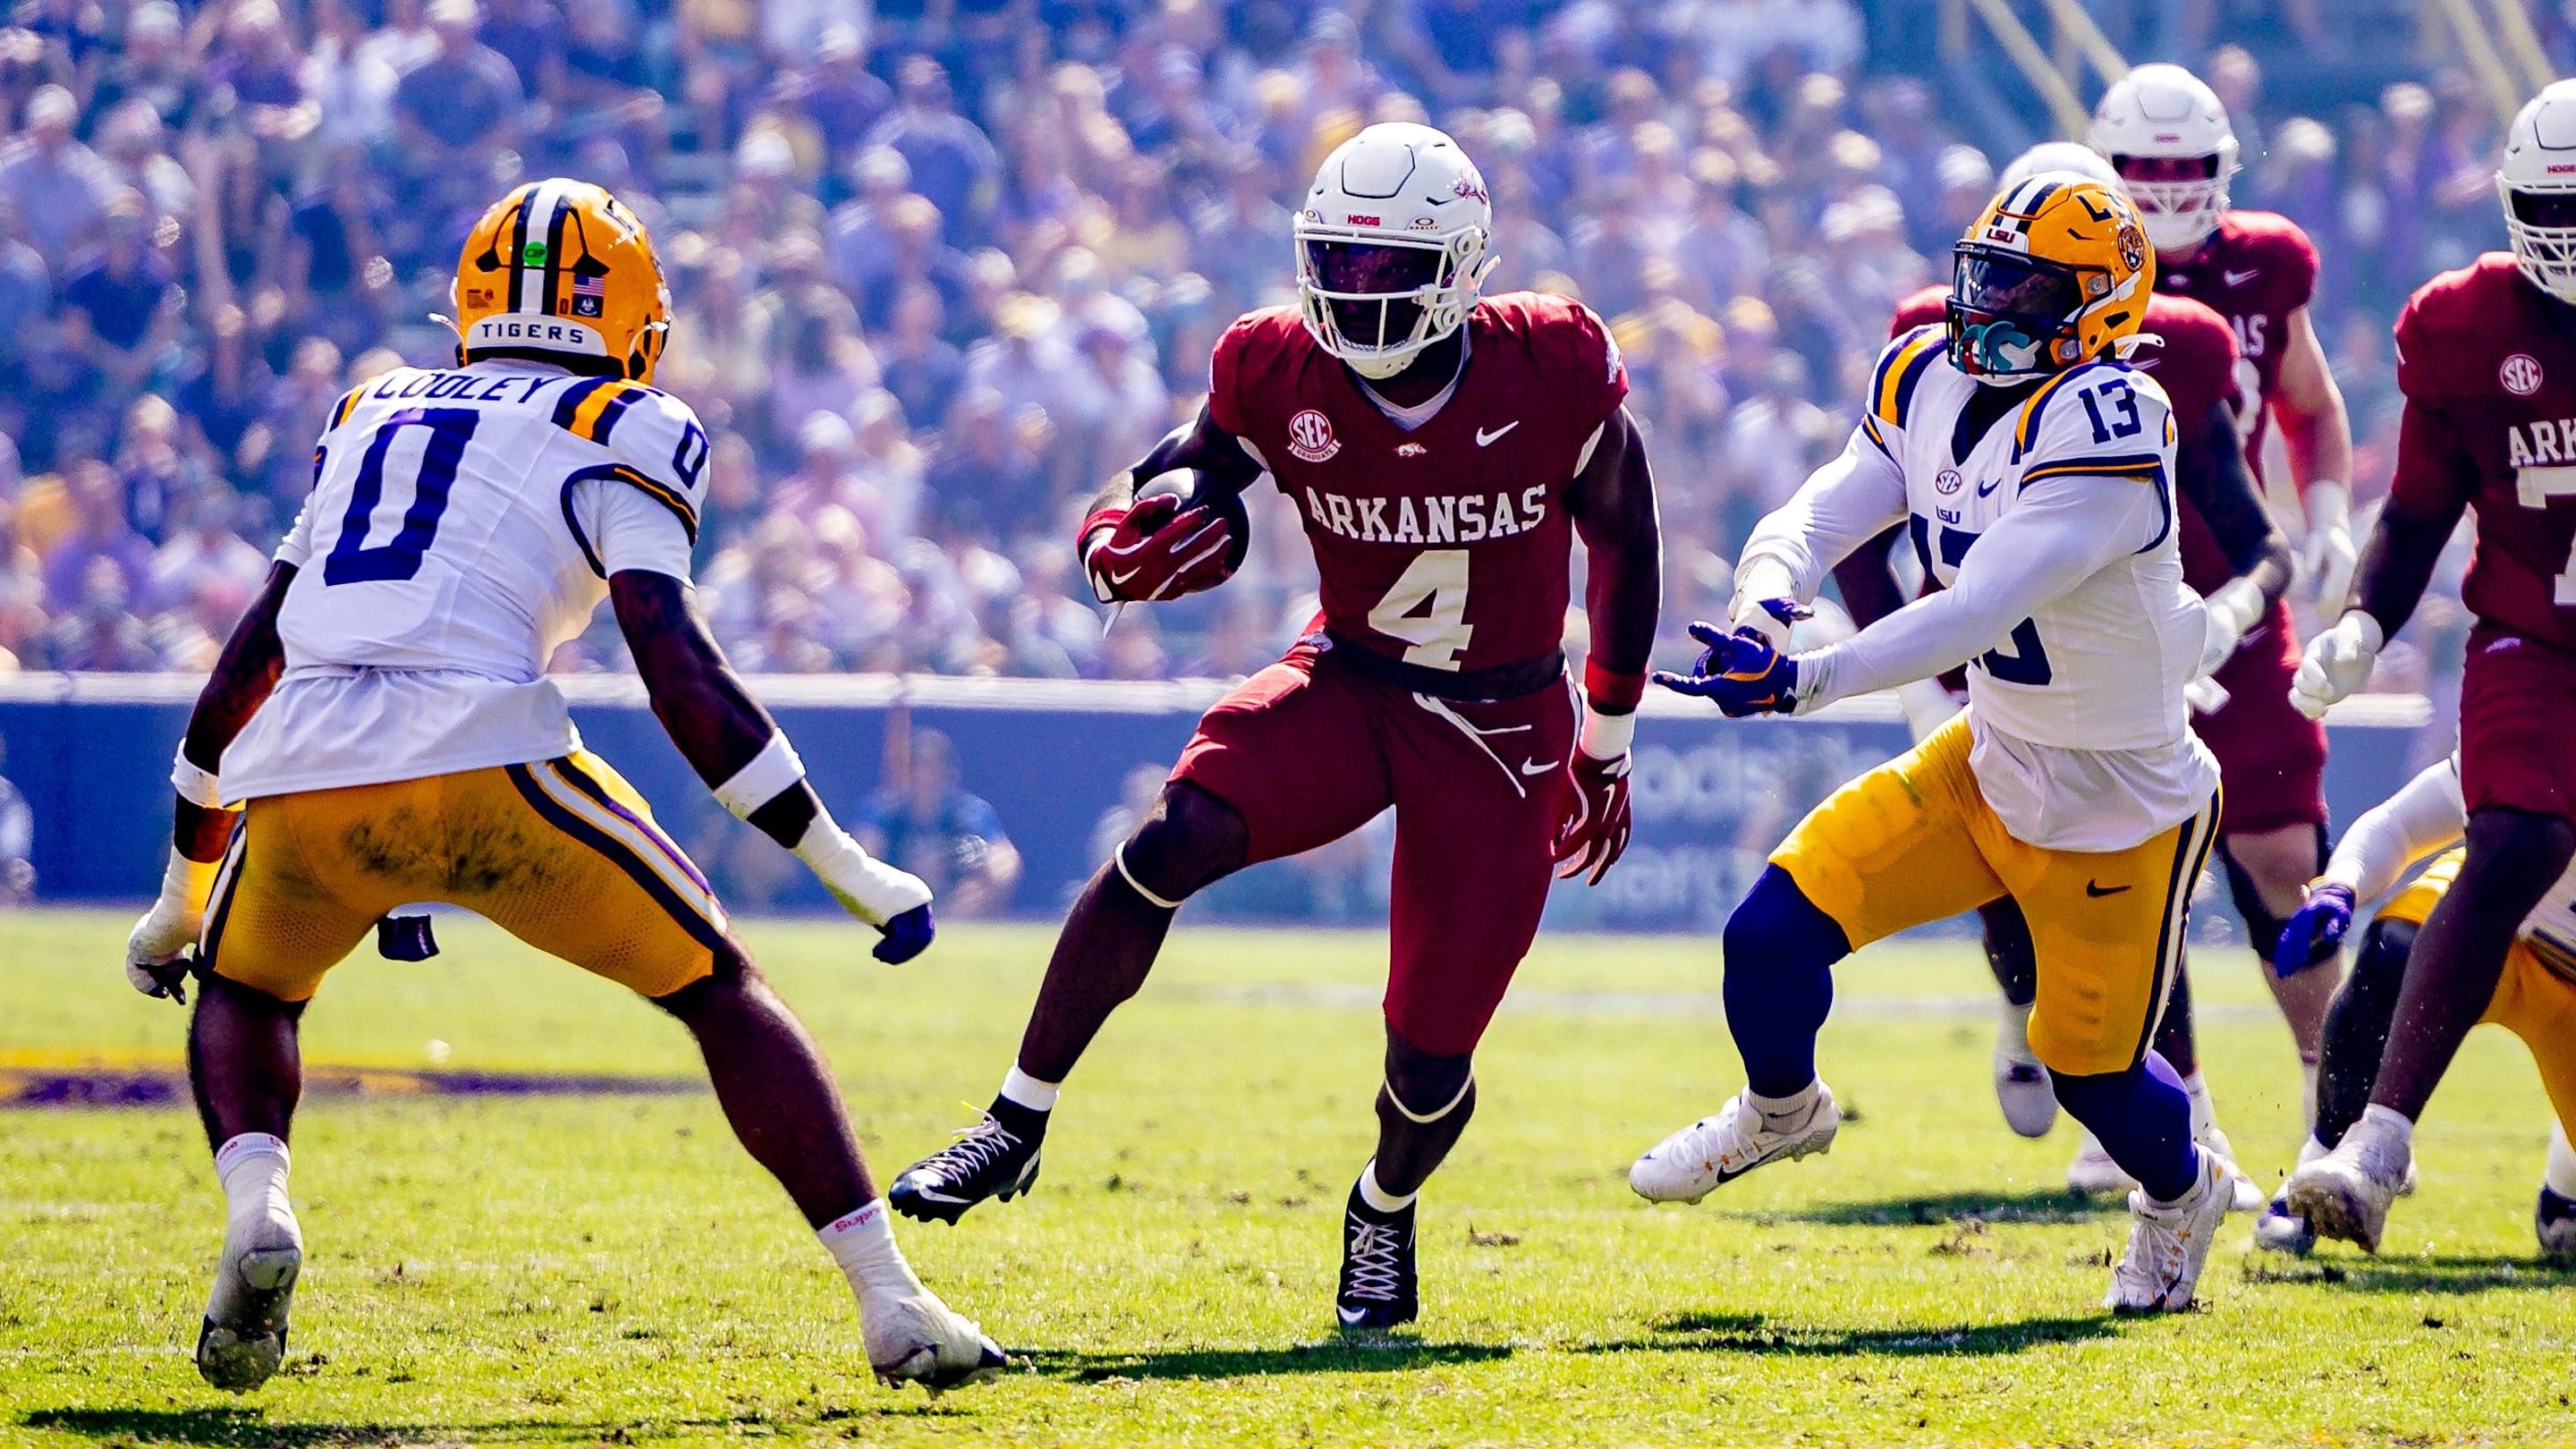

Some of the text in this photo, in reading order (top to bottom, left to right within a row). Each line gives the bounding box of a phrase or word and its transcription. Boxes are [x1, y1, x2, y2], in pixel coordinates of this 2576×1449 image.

[1347, 214, 1380, 227] HOGS
[1986, 227, 2015, 244] LSU
[481, 323, 584, 344] TIGERS
[373, 373, 566, 403] COOLEY
[2504, 357, 2538, 392] SEC
[2078, 378, 2142, 445] 13
[1292, 412, 1328, 448] SEC
[672, 419, 710, 490] 0
[324, 407, 480, 587] 0
[1306, 483, 1546, 544] ARKANSAS
[1936, 504, 1962, 525] LSU
[1368, 548, 1474, 673] 4
